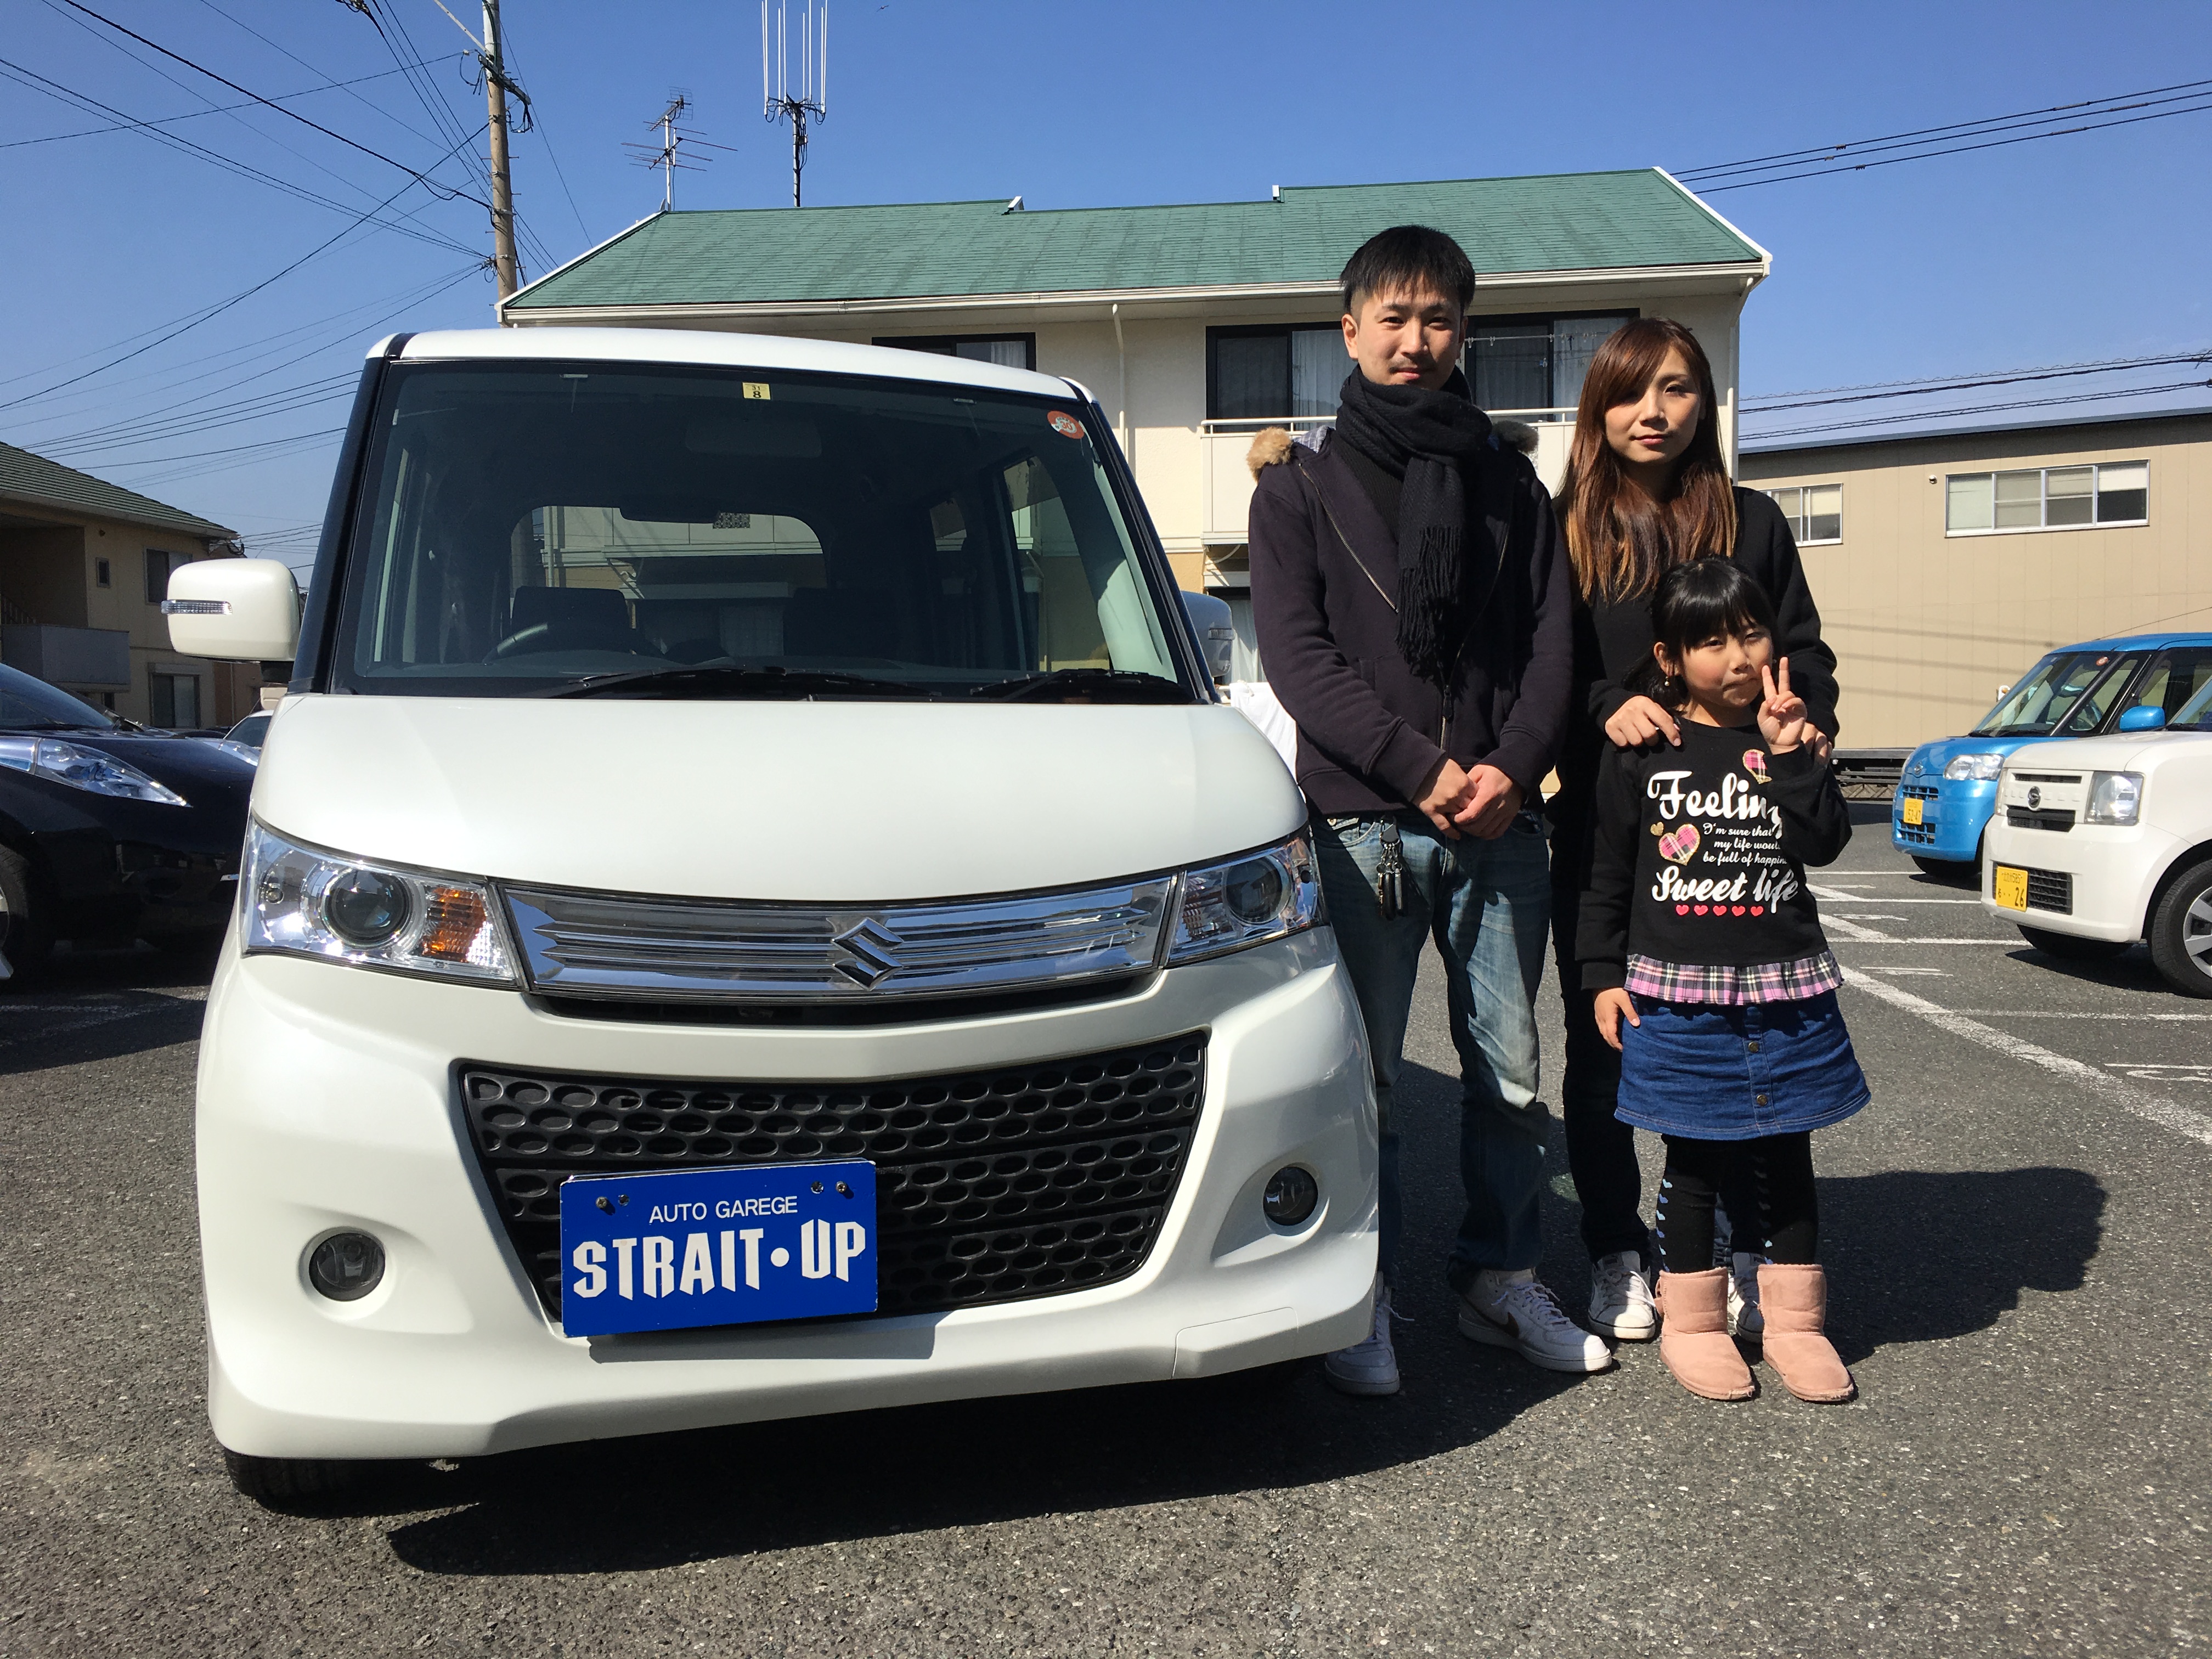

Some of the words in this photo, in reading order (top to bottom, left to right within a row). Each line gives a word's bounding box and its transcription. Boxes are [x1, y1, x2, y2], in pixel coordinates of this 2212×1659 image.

[1060, 421, 1074, 431] 30
[1702, 822, 1727, 835] I'm
[1728, 828, 1751, 836] sure
[1752, 825, 1773, 837] that
[1714, 840, 1732, 851] my
[1734, 837, 1753, 852] life
[1754, 841, 1781, 850] woul
[1703, 851, 1717, 862] be
[1717, 851, 1740, 866] full
[1741, 852, 1753, 867] of
[1754, 853, 1787, 867] happin
[1651, 865, 1748, 902] Sweet
[1753, 868, 1798, 913] life
[649, 1203, 707, 1223] AUTO
[715, 1196, 798, 1218] GAREGE
